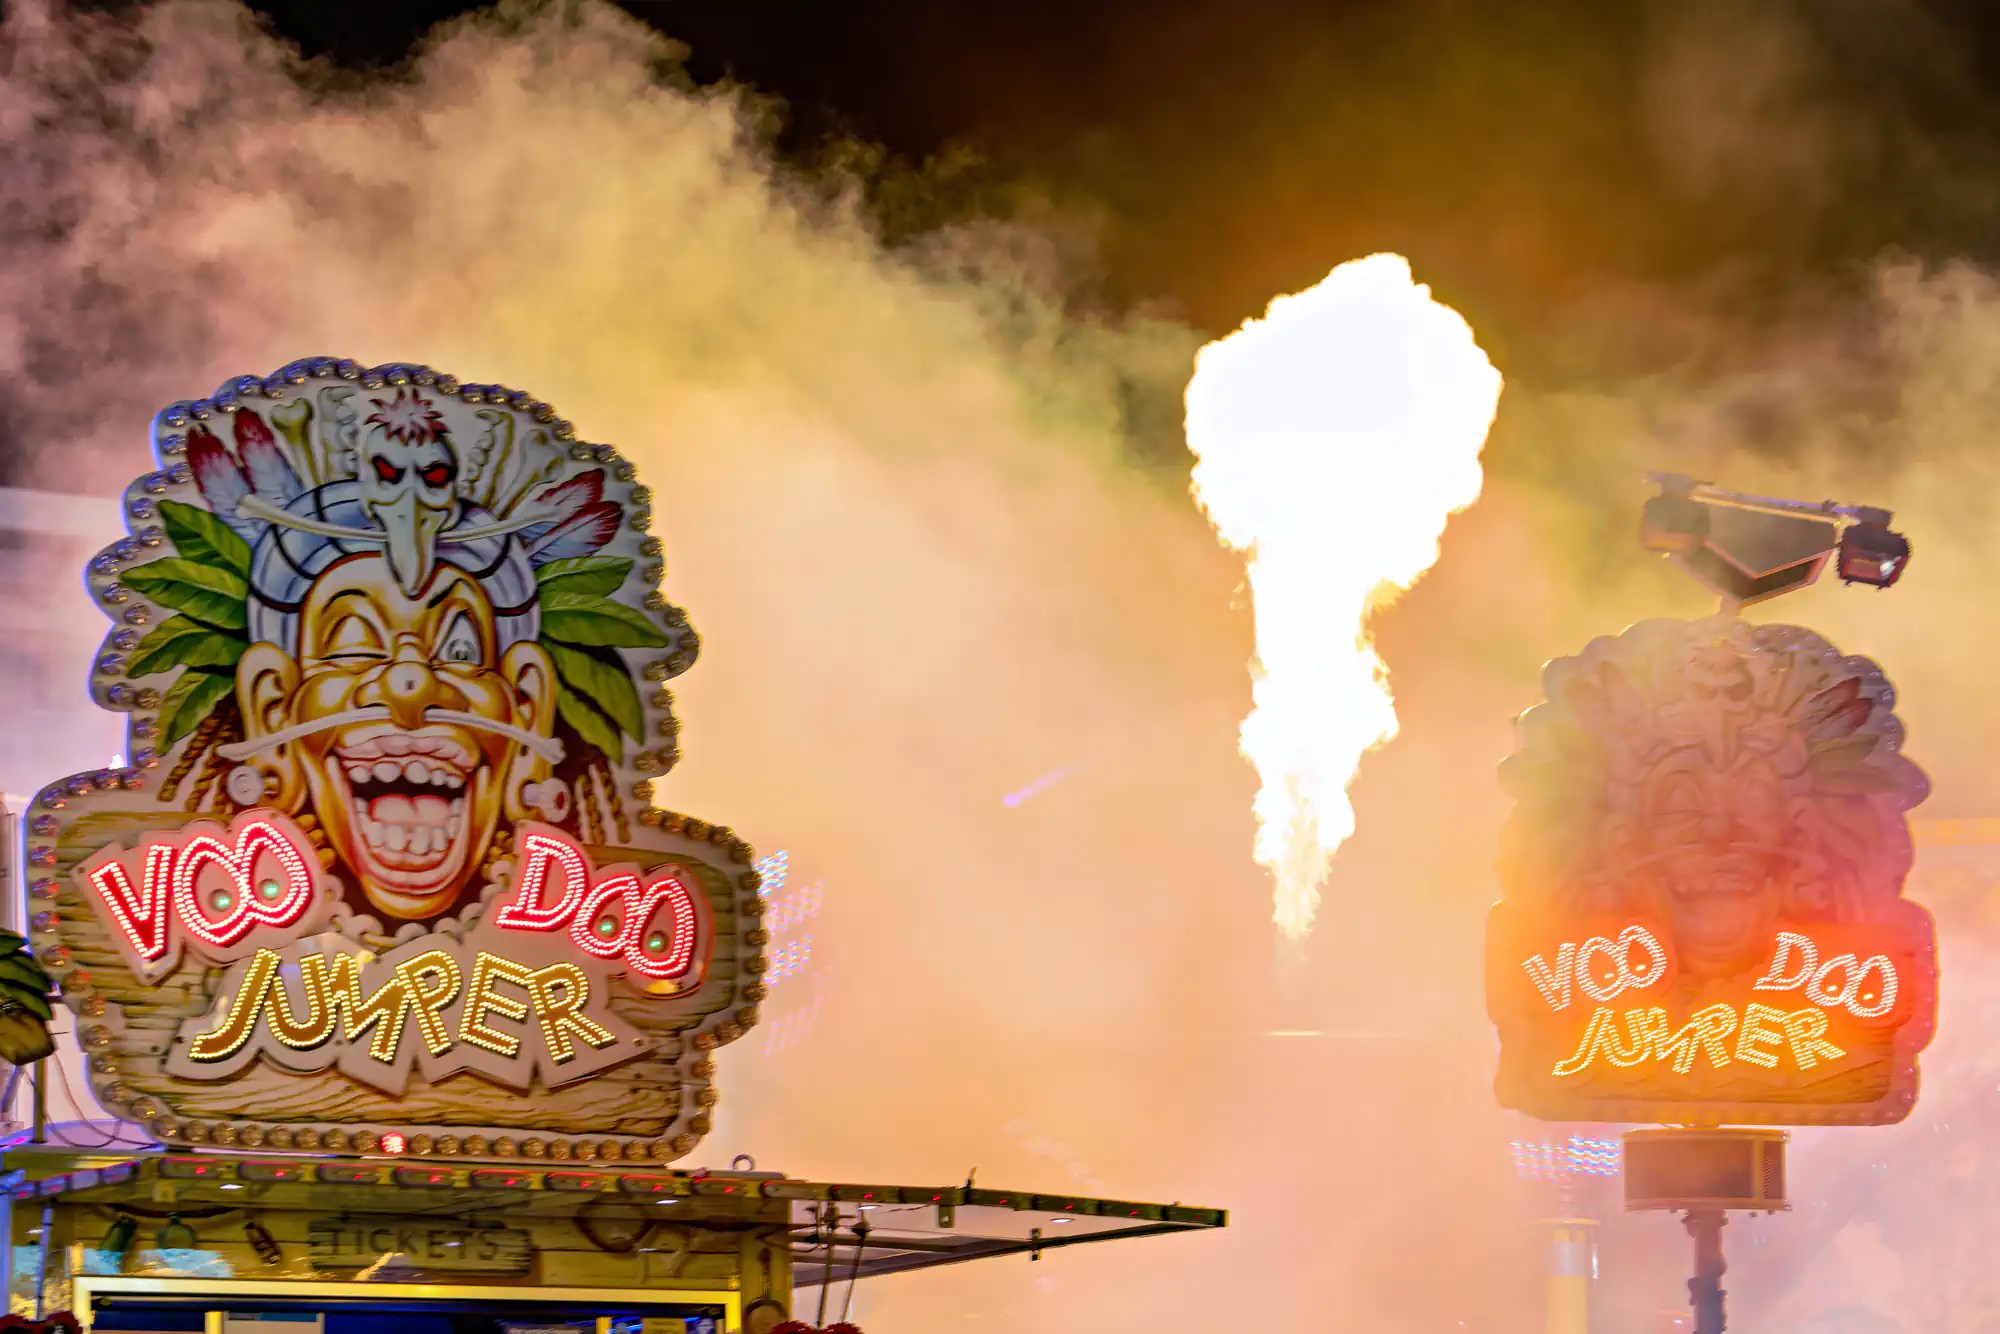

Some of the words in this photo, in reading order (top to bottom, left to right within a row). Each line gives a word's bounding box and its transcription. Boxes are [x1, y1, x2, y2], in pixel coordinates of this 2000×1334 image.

[89, 821, 310, 960] VOO
[497, 833, 696, 977] DOO
[188, 948, 616, 1062] JUMPER
[1521, 925, 1667, 1011] VOO
[1753, 932, 1899, 1018] DOO
[1552, 1002, 1847, 1075] JUMPER
[329, 1227, 499, 1261] TICKETS
